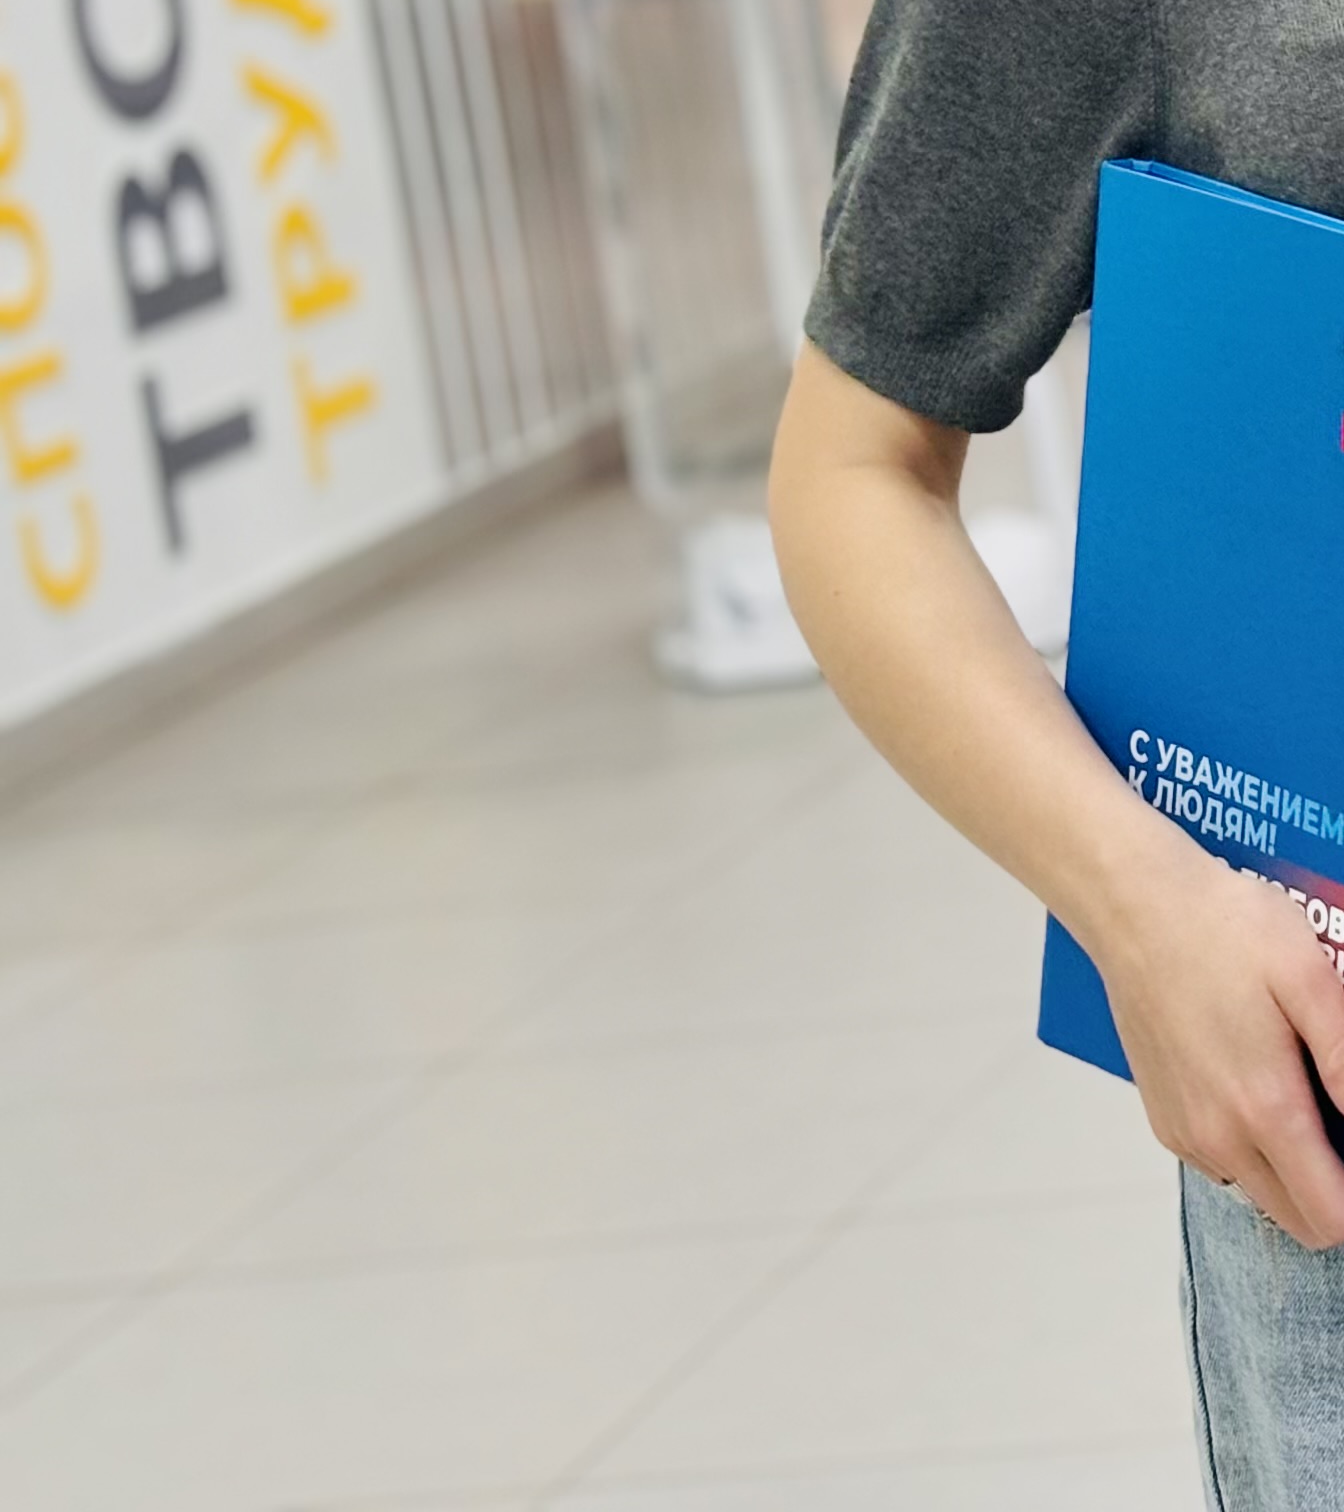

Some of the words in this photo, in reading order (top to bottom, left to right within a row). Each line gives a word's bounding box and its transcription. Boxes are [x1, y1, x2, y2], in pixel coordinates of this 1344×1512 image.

[1129, 729, 1150, 764] С
[1156, 737, 1344, 846] УВАЖЕНИЕМ
[1152, 776, 1278, 857] ЛЮДЯМ!
